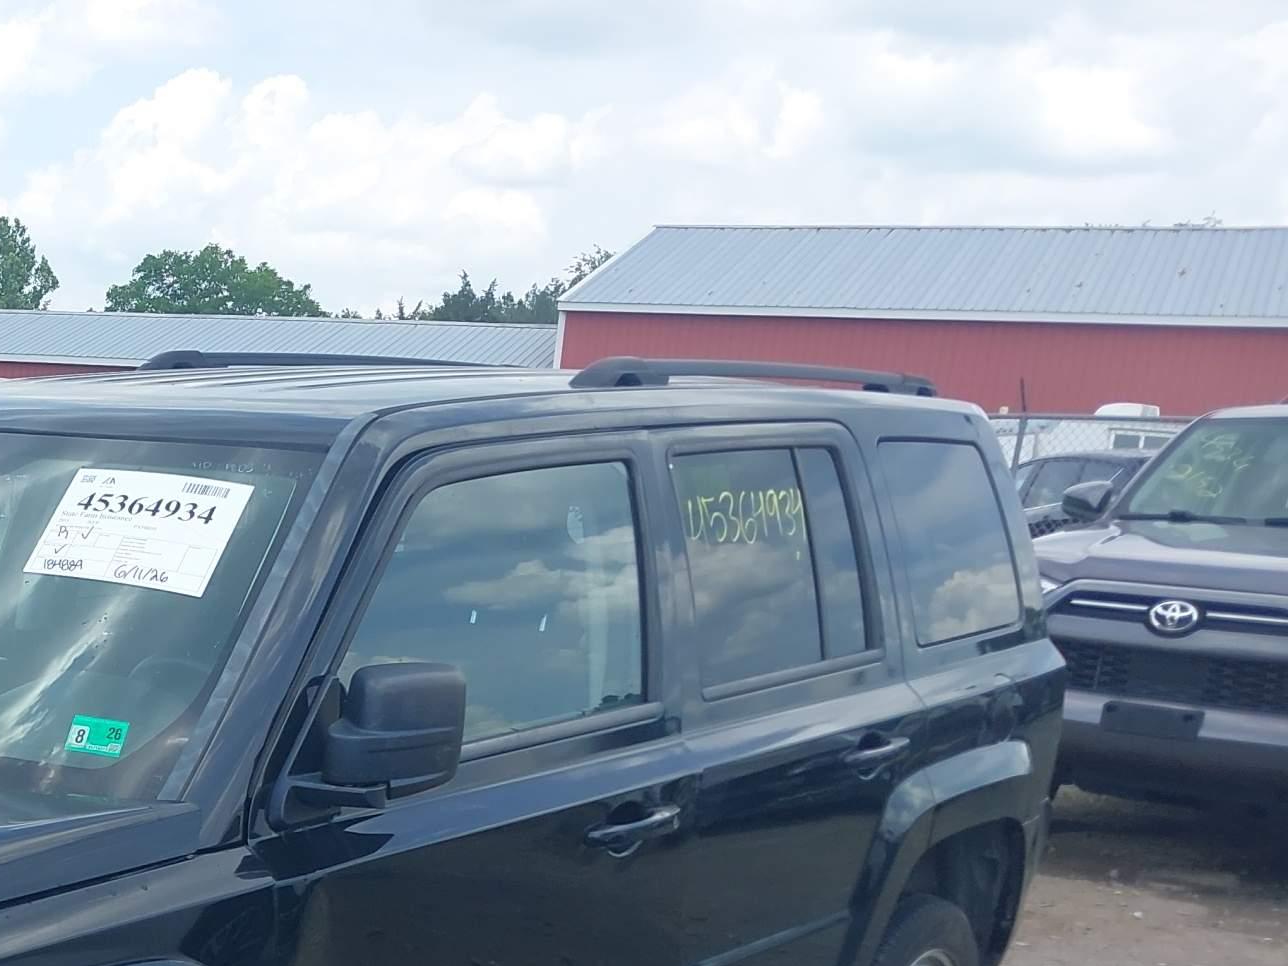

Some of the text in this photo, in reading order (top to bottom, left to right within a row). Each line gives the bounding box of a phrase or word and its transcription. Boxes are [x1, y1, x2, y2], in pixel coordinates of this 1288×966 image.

[77, 491, 217, 526] 45364934
[113, 563, 169, 583] 6/11/26
[75, 729, 86, 743] 8
[106, 727, 122, 740] 26
